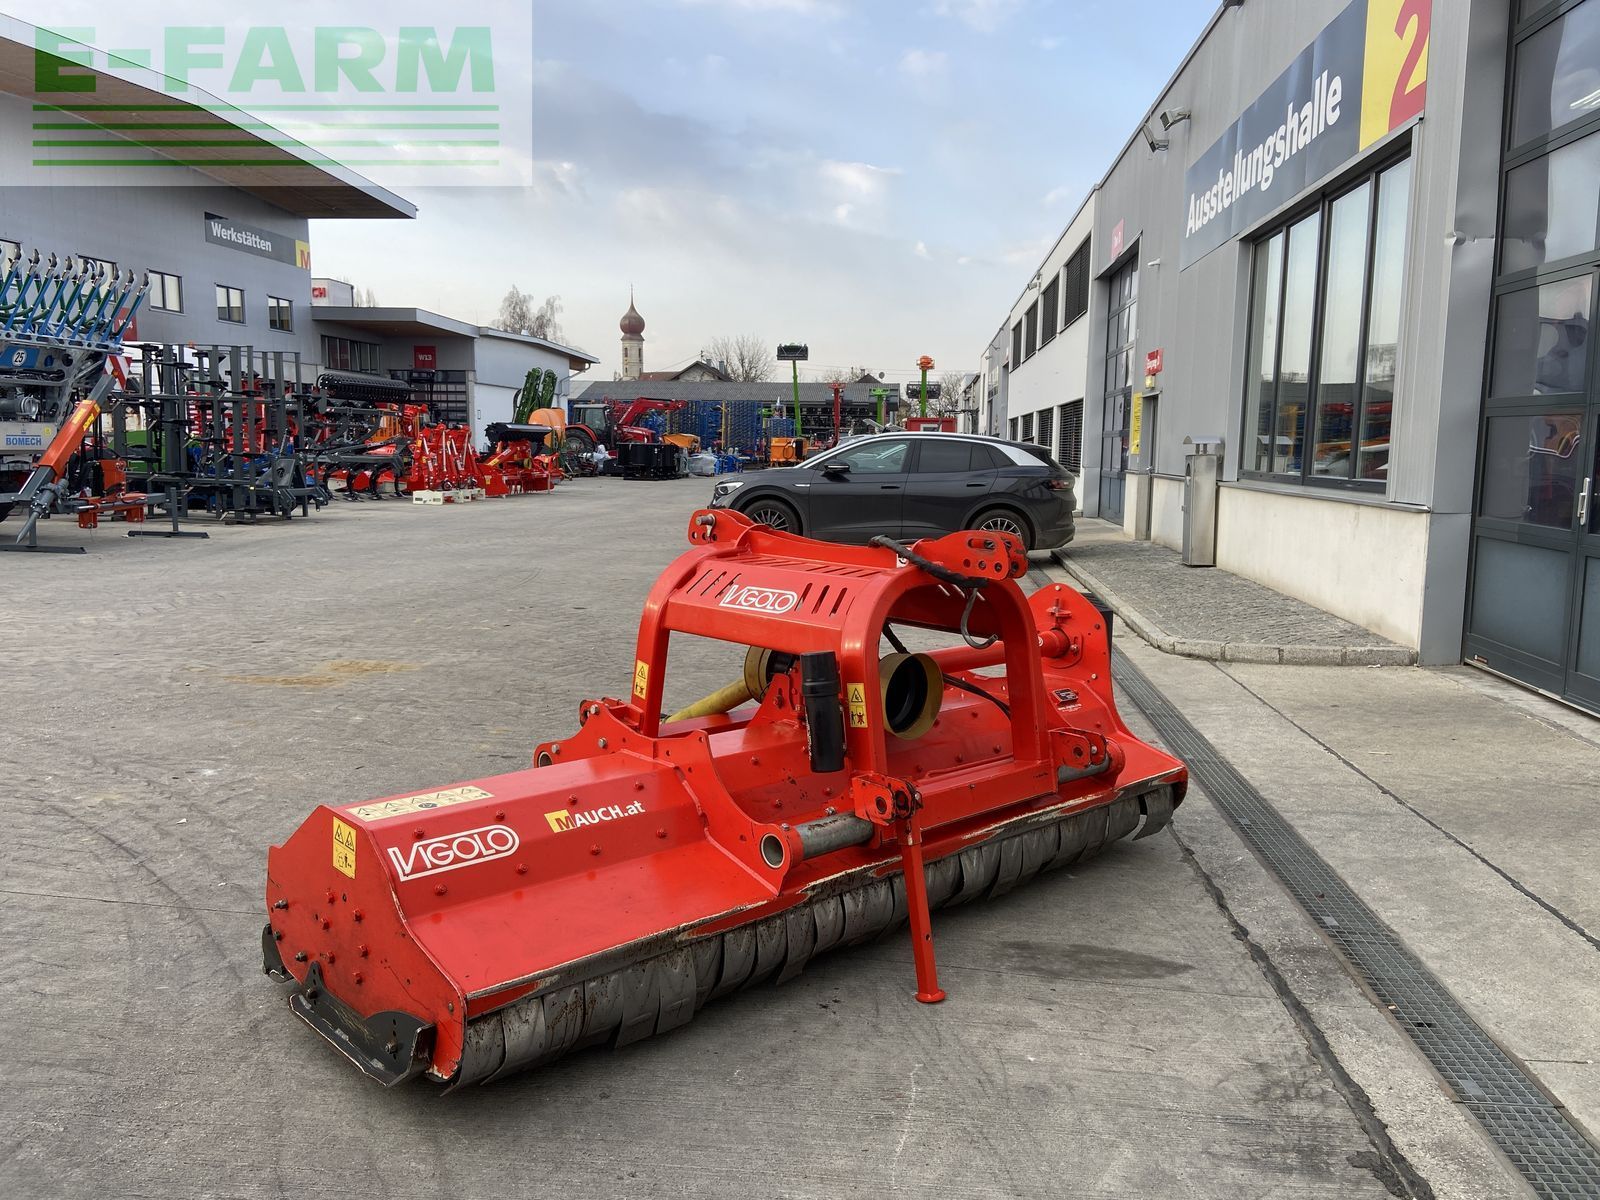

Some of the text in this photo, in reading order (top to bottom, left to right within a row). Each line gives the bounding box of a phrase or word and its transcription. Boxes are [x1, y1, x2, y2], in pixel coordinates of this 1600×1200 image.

[1186, 0, 1432, 238] Ausstellungshalle 2
[211, 221, 273, 252] Werkstätten
[14, 351, 25, 363] 25
[5, 437, 42, 446] BOMECH
[719, 585, 796, 613] VIGOLO
[555, 800, 646, 831] MAUCH.at
[387, 825, 519, 881] VIGOLO
